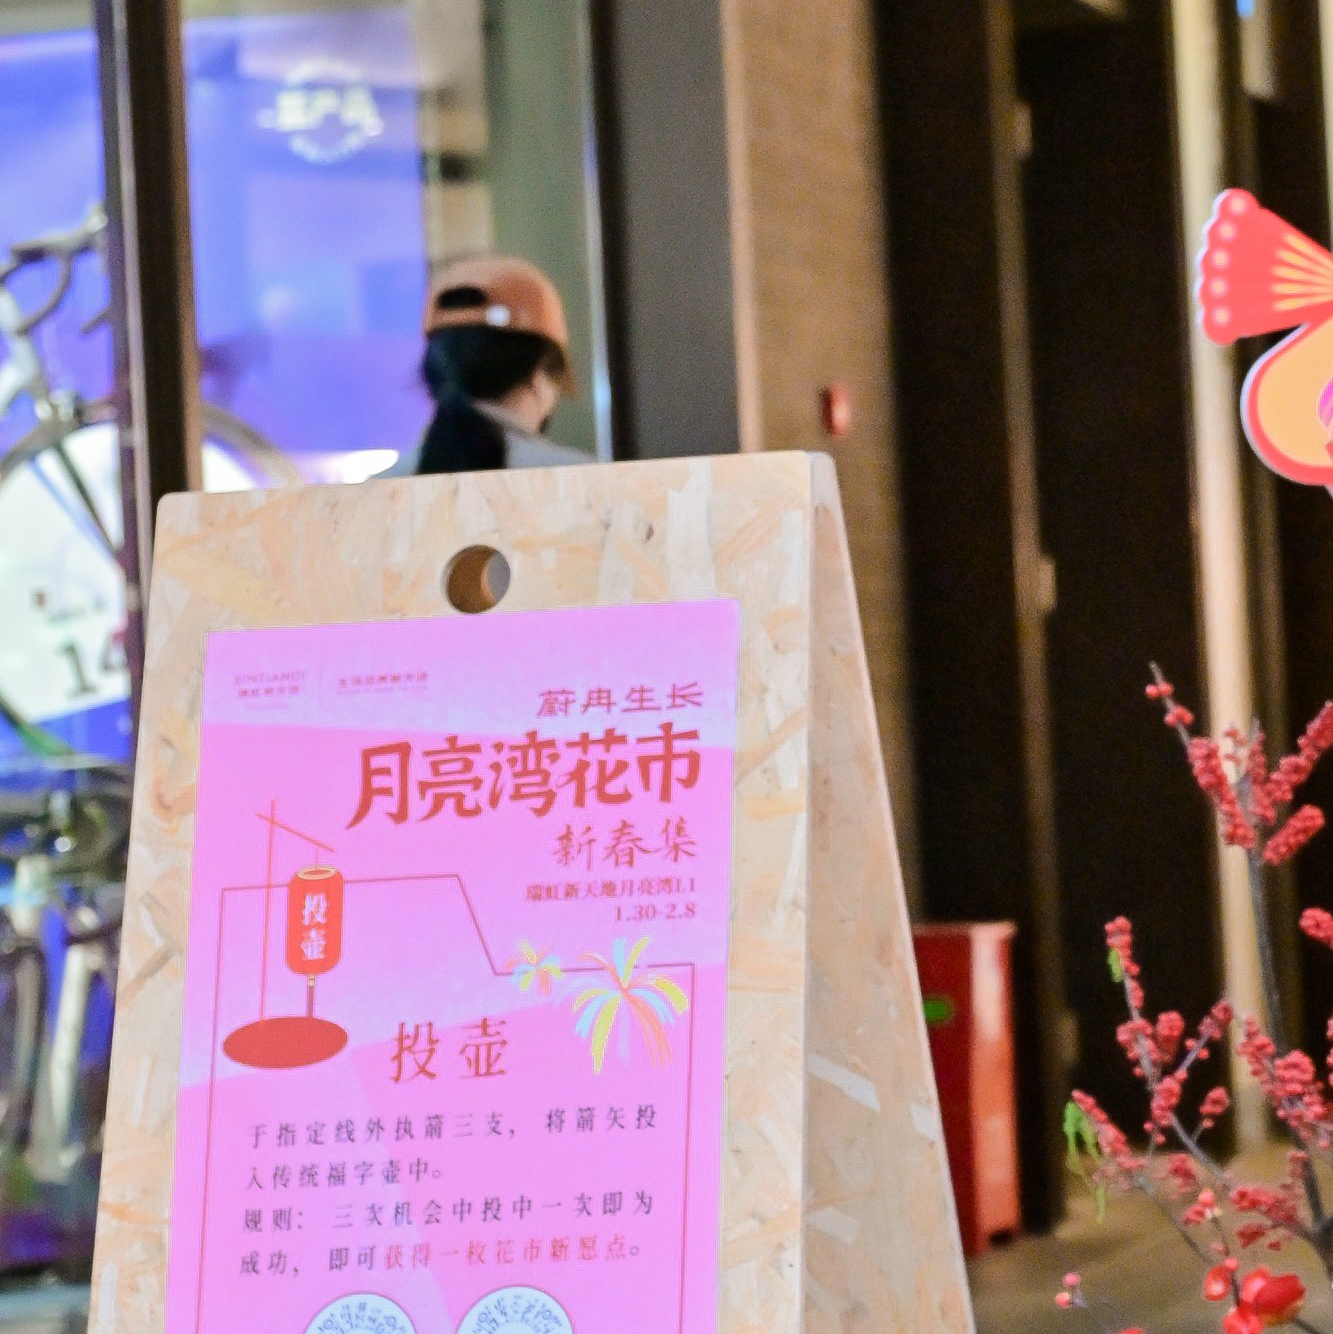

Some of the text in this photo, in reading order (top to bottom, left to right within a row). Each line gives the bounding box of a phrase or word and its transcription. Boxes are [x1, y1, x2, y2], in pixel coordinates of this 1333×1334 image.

[346, 721, 701, 830] 月亮湾花市
[551, 817, 698, 872] 新春集
[389, 1016, 509, 1084] 投壶
